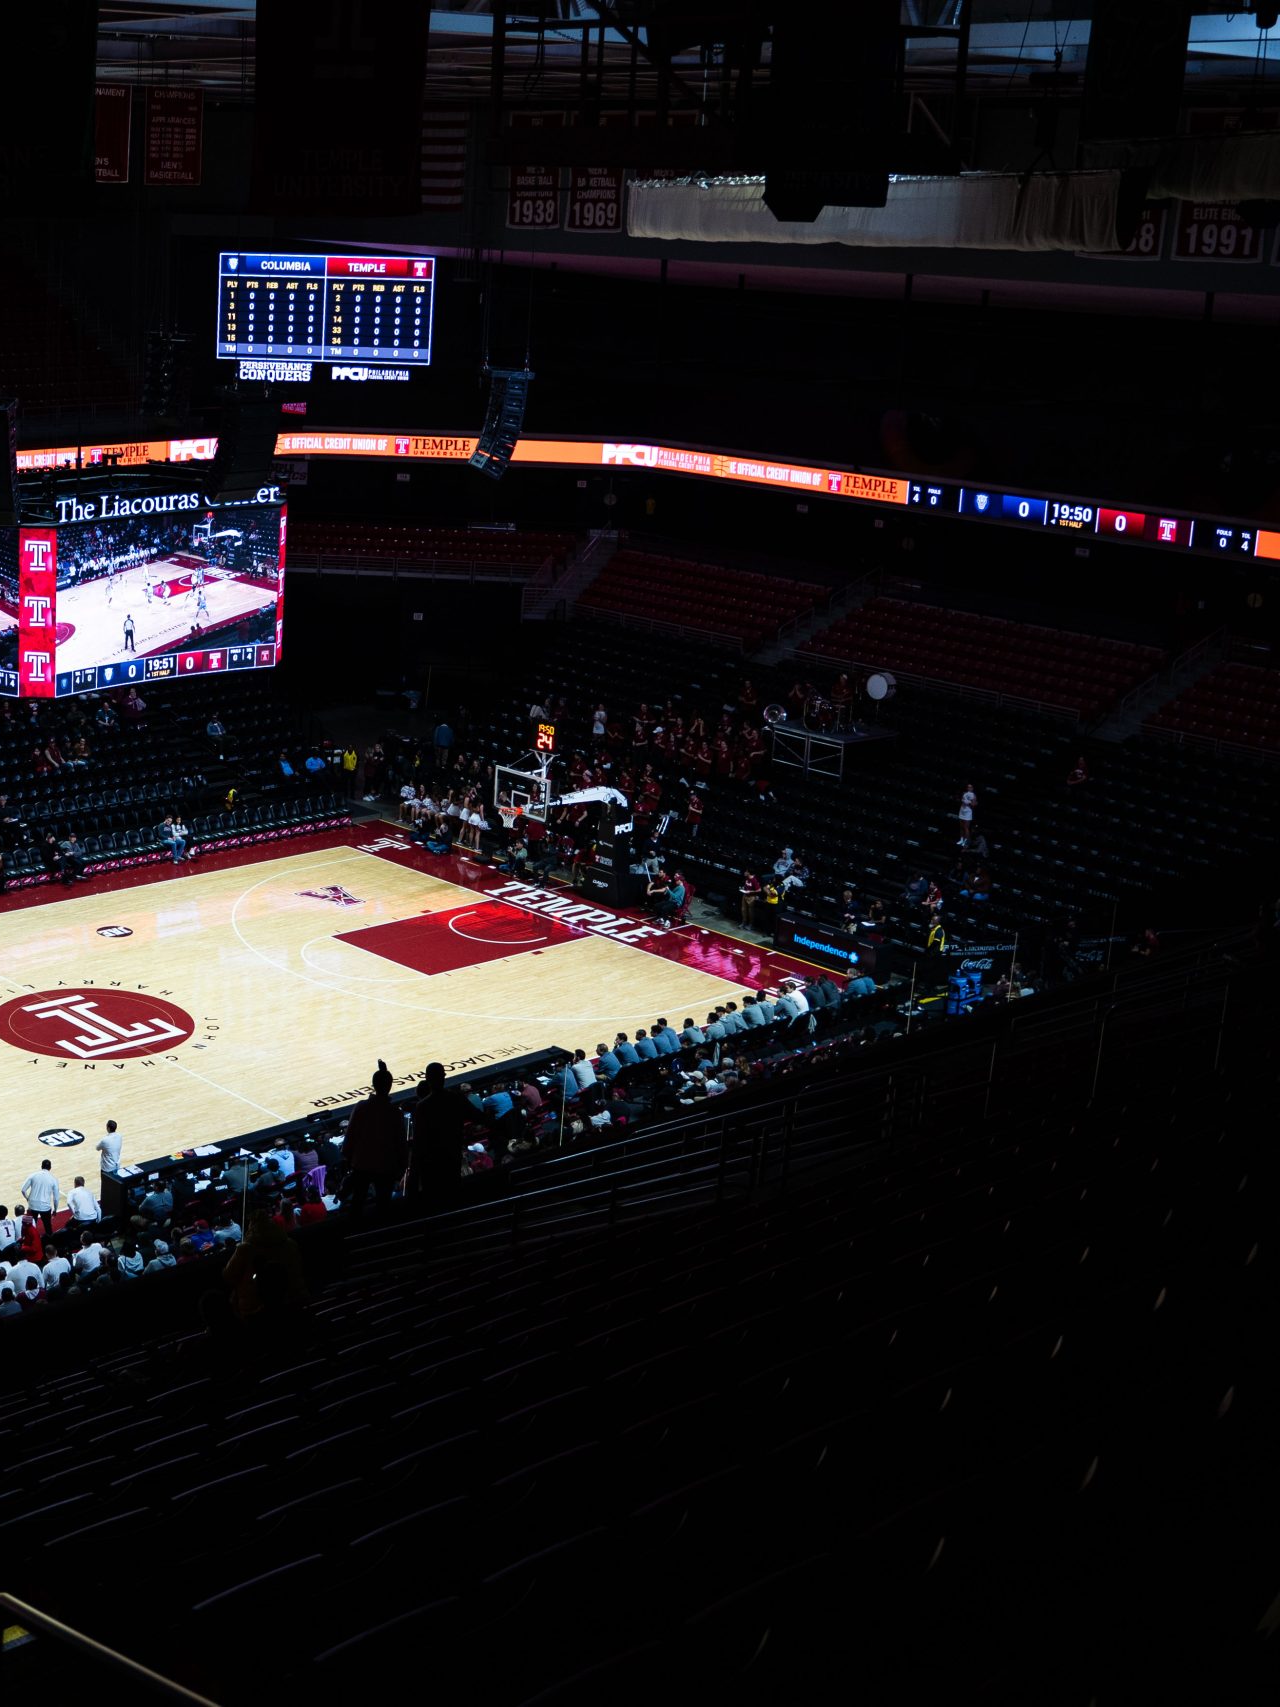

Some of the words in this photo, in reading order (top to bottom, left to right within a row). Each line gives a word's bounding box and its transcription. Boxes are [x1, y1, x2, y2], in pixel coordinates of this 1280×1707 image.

[150, 171, 194, 180] BASKETBALL
[577, 177, 617, 188] BAKETBALL
[577, 190, 616, 200] CHAMPIONS
[512, 200, 555, 224] 1938
[573, 201, 618, 227] 1969
[1186, 223, 1253, 256] 1991
[261, 261, 311, 271] COLUMBIA
[348, 262, 386, 273] TEMPLE
[332, 337, 341, 345] 34
[240, 361, 312, 371] PERSEVERANCE
[240, 370, 311, 382] CONQUERS
[332, 366, 369, 381] PFCU
[170, 438, 218, 462] PFCU
[292, 437, 323, 449] OFFICIAL
[324, 437, 351, 449] CREDIT
[352, 438, 376, 450] UNION
[378, 439, 387, 450] OF
[412, 438, 470, 451] TEMPLE
[104, 445, 149, 457] TEMPLE
[602, 443, 659, 467] PFCU
[659, 450, 710, 465] PHILADELPHIA
[34, 453, 56, 466] CREDIT
[737, 462, 765, 478] OFFICIAL
[766, 466, 790, 482] CREDIT
[790, 470, 812, 484] UNION
[812, 473, 822, 486] OF
[844, 475, 897, 494] TEMPLE
[844, 488, 897, 500] UNIVERSITY
[913, 493, 919, 502] 4
[930, 496, 937, 505] 0
[56, 498, 94, 523] The
[100, 492, 199, 518] Liacouras
[1018, 502, 1029, 517] 0
[1052, 504, 1092, 522] 19:50
[1059, 519, 1069, 527] 1ST
[1115, 515, 1127, 531] 0
[1217, 529, 1232, 537] FOULS
[1219, 538, 1227, 547] 0
[1241, 541, 1248, 551] 4
[25, 540, 51, 571] T
[24, 596, 50, 627] T
[246, 652, 252, 660] 4
[24, 651, 50, 682] T
[148, 657, 174, 671] 19:51
[185, 657, 194, 670] 0
[128, 664, 136, 678] 0
[76, 676, 80, 685] 4
[87, 674, 92, 682] 0
[538, 724, 554, 735] 19:50
[537, 733, 553, 750] 24
[614, 819, 633, 835] PFCU
[483, 880, 670, 943] TEMPLE
[794, 933, 848, 959] Independence
[492, 1043, 533, 1057] THE
[392, 1053, 495, 1086] LIACORAS
[309, 1085, 376, 1108] ENTER
[4, 1226, 11, 1238] 1
